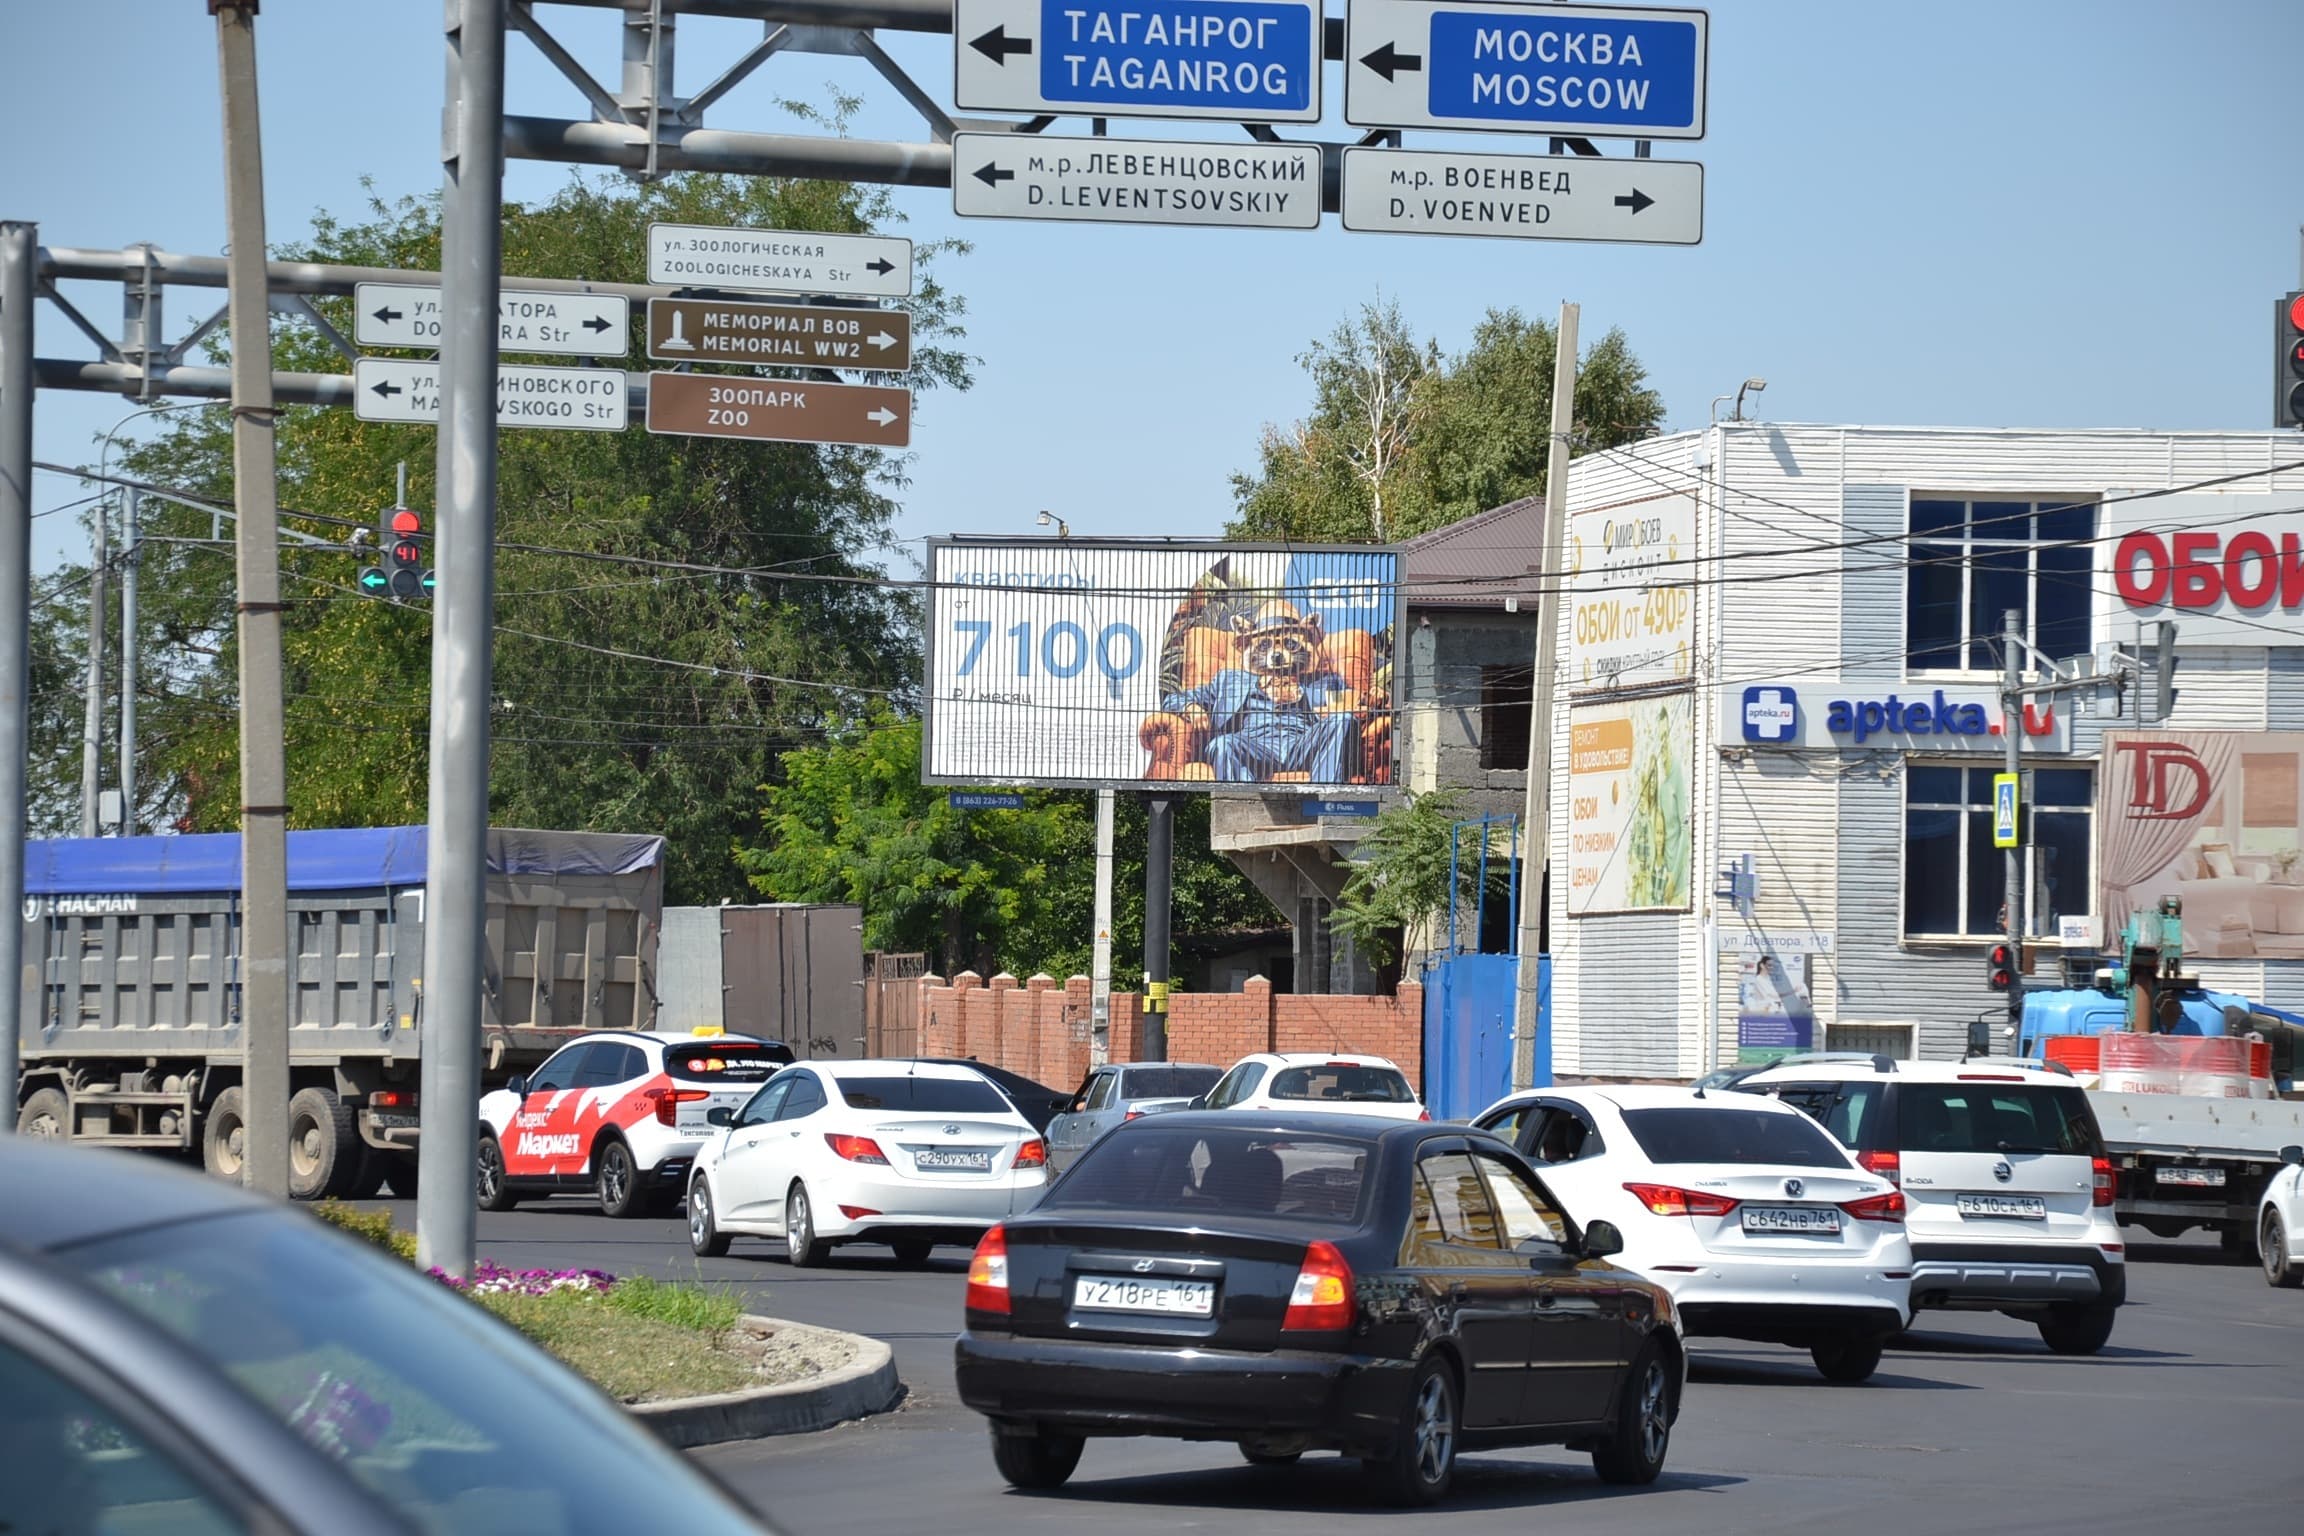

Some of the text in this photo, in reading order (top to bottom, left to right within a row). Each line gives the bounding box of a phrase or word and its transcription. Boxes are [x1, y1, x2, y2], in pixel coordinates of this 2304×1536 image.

[1063, 10, 1278, 50] ТАГАНРОГ
[1473, 28, 1643, 67] МОСКВА
[1063, 55, 1288, 95] TAGANROG
[1472, 72, 1651, 111] MOSCOW
[1444, 167, 1572, 195] ВОЕНВЕД
[1028, 185, 1289, 213] D. LEVENTSOVSKIY
[1390, 198, 1551, 224] D. VOENVED
[689, 239, 825, 258] ЗООЛОГИЧЕСКАЯ
[664, 261, 852, 282] ZOOLOGICHESKAYA Str
[539, 326, 571, 342] Str
[703, 313, 861, 336] МЕМОРИАЛ ВОВ
[702, 335, 861, 359] MEMORIAL WW2
[708, 387, 806, 409] ЗООПАРК
[583, 403, 614, 419] Str
[707, 408, 749, 427] ZOO
[396, 546, 416, 561] 41
[955, 571, 1096, 596] квартиры
[1577, 599, 1620, 646] ОБОИ
[954, 620, 1144, 681] 7100
[1748, 709, 1791, 719] apteka.ru
[1827, 690, 2053, 743] apteka.u
[1573, 797, 1599, 821] ОБОИ
[1572, 867, 1599, 889] ЦЕНАМ
[516, 1133, 580, 1158] Маркет
[1748, 1210, 1834, 1228] С642НВ 761
[1085, 1280, 1207, 1307] У218РЕ 161
